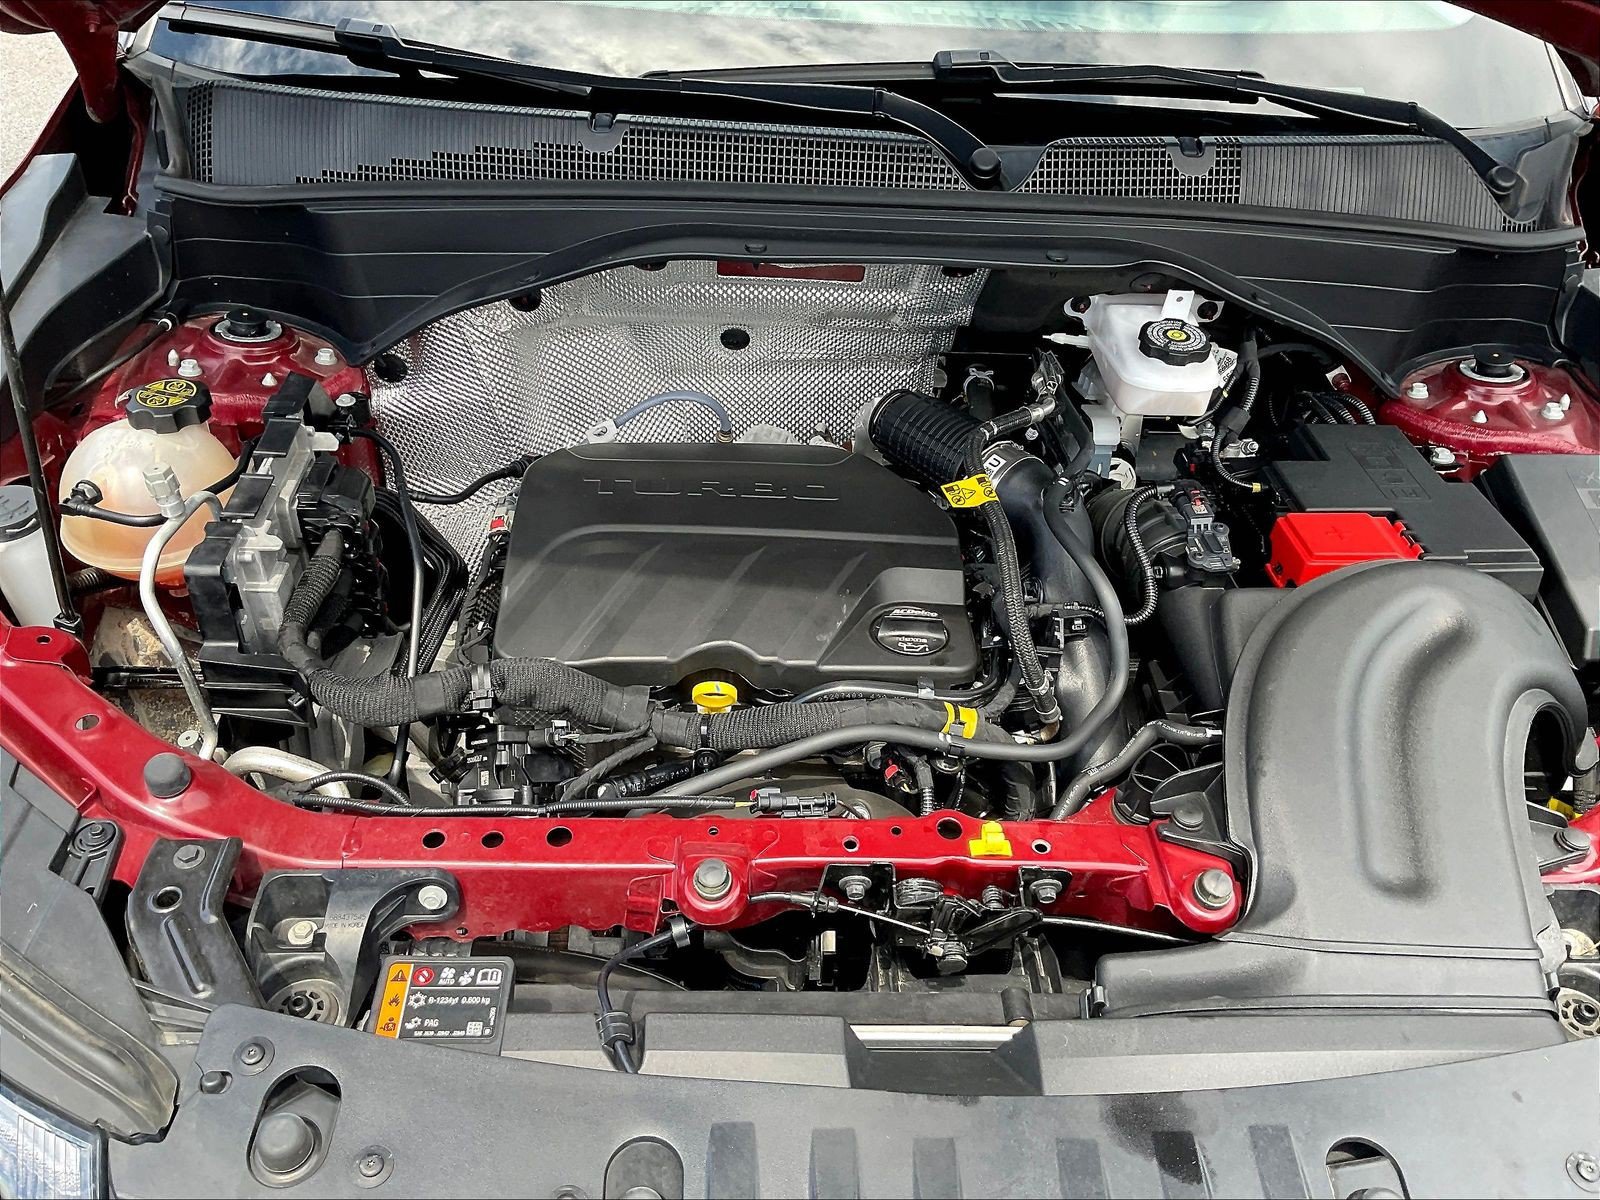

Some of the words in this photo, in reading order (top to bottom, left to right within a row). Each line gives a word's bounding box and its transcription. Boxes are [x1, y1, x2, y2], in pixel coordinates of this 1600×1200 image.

[988, 457, 1001, 468] U
[583, 478, 840, 502] TURBO
[889, 607, 939, 618] ACDelco
[480, 996, 491, 1005] kg
[423, 1018, 440, 1027] PAG
